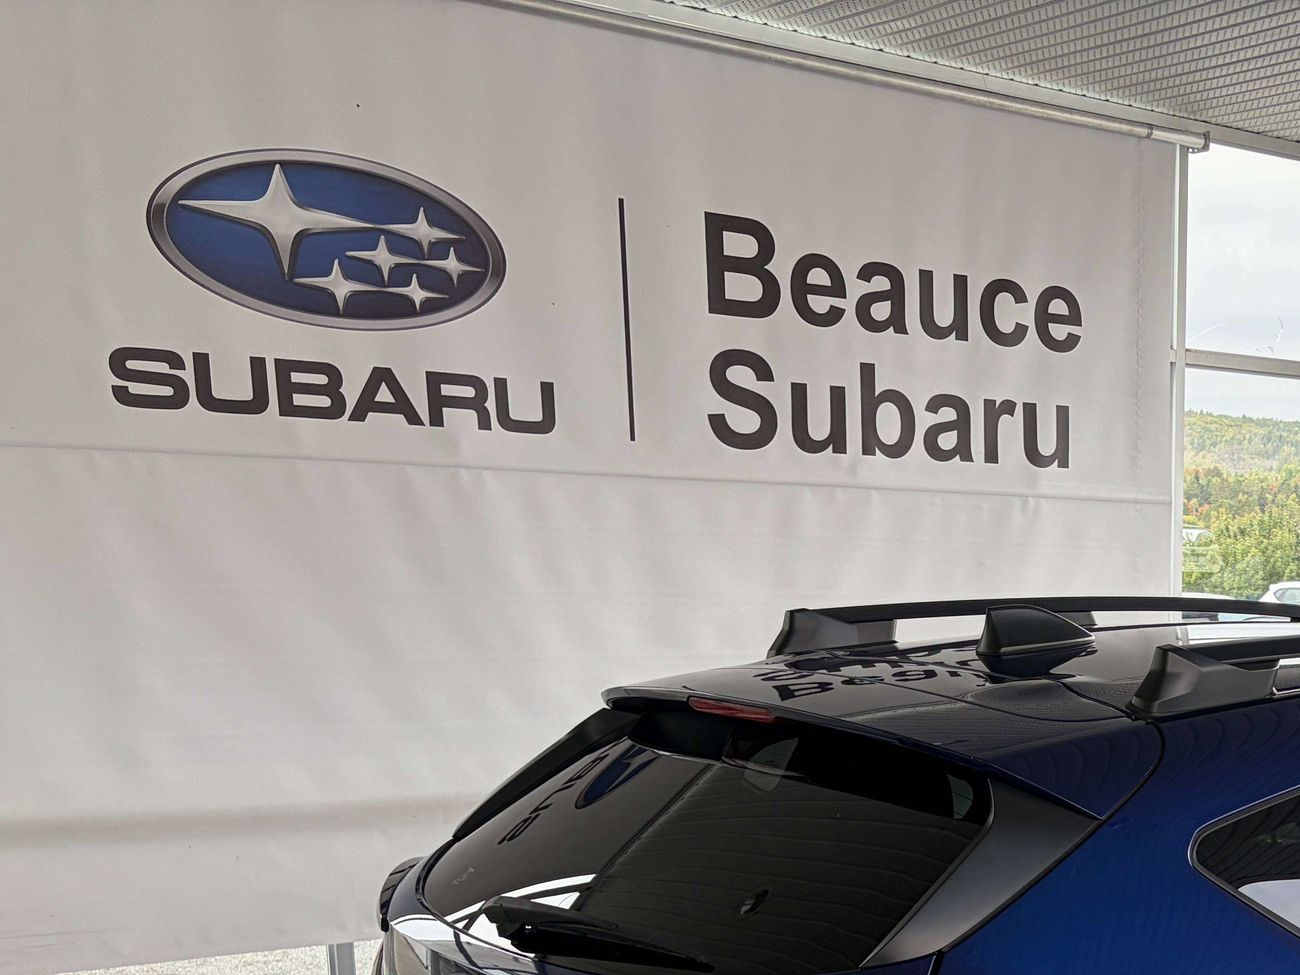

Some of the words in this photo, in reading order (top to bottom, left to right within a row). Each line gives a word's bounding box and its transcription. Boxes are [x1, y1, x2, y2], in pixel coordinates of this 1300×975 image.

[703, 211, 1083, 353] Beauce
[108, 346, 556, 435] SUBARU
[707, 348, 1070, 469] Subaru
